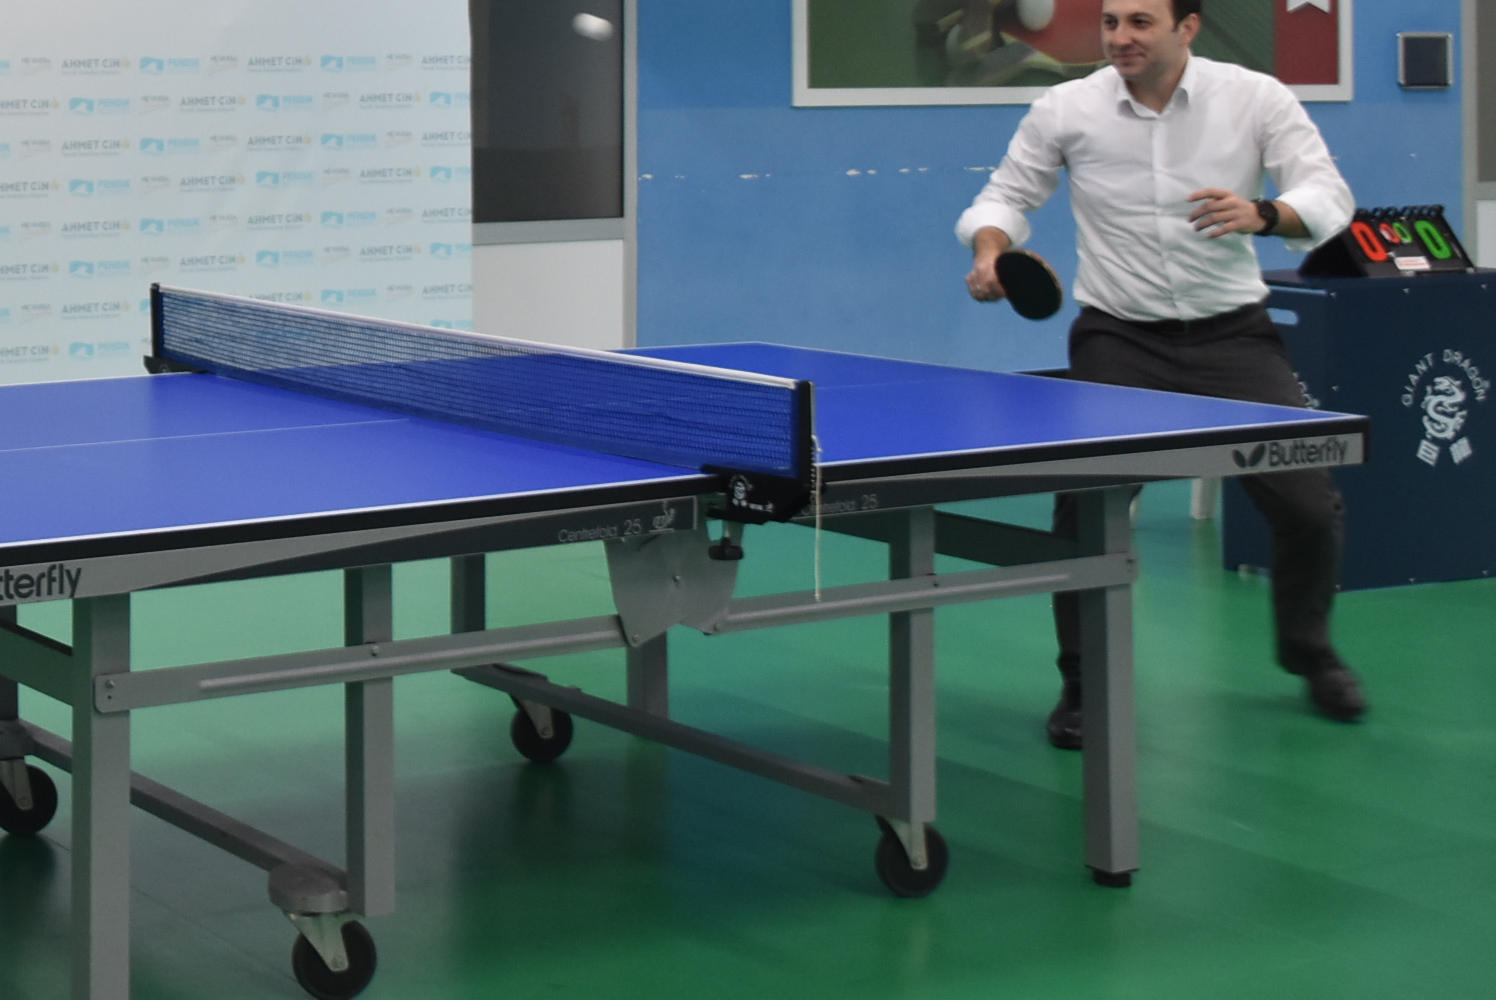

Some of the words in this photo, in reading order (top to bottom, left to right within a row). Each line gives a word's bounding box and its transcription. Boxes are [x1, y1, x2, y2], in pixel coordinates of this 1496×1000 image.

[1350, 221, 1388, 262] 0
[1415, 220, 1451, 259] 0
[1400, 352, 1434, 407] GIANT
[1442, 349, 1486, 401] DRAGON
[1268, 439, 1349, 467] Butterfly
[623, 518, 642, 535] 25
